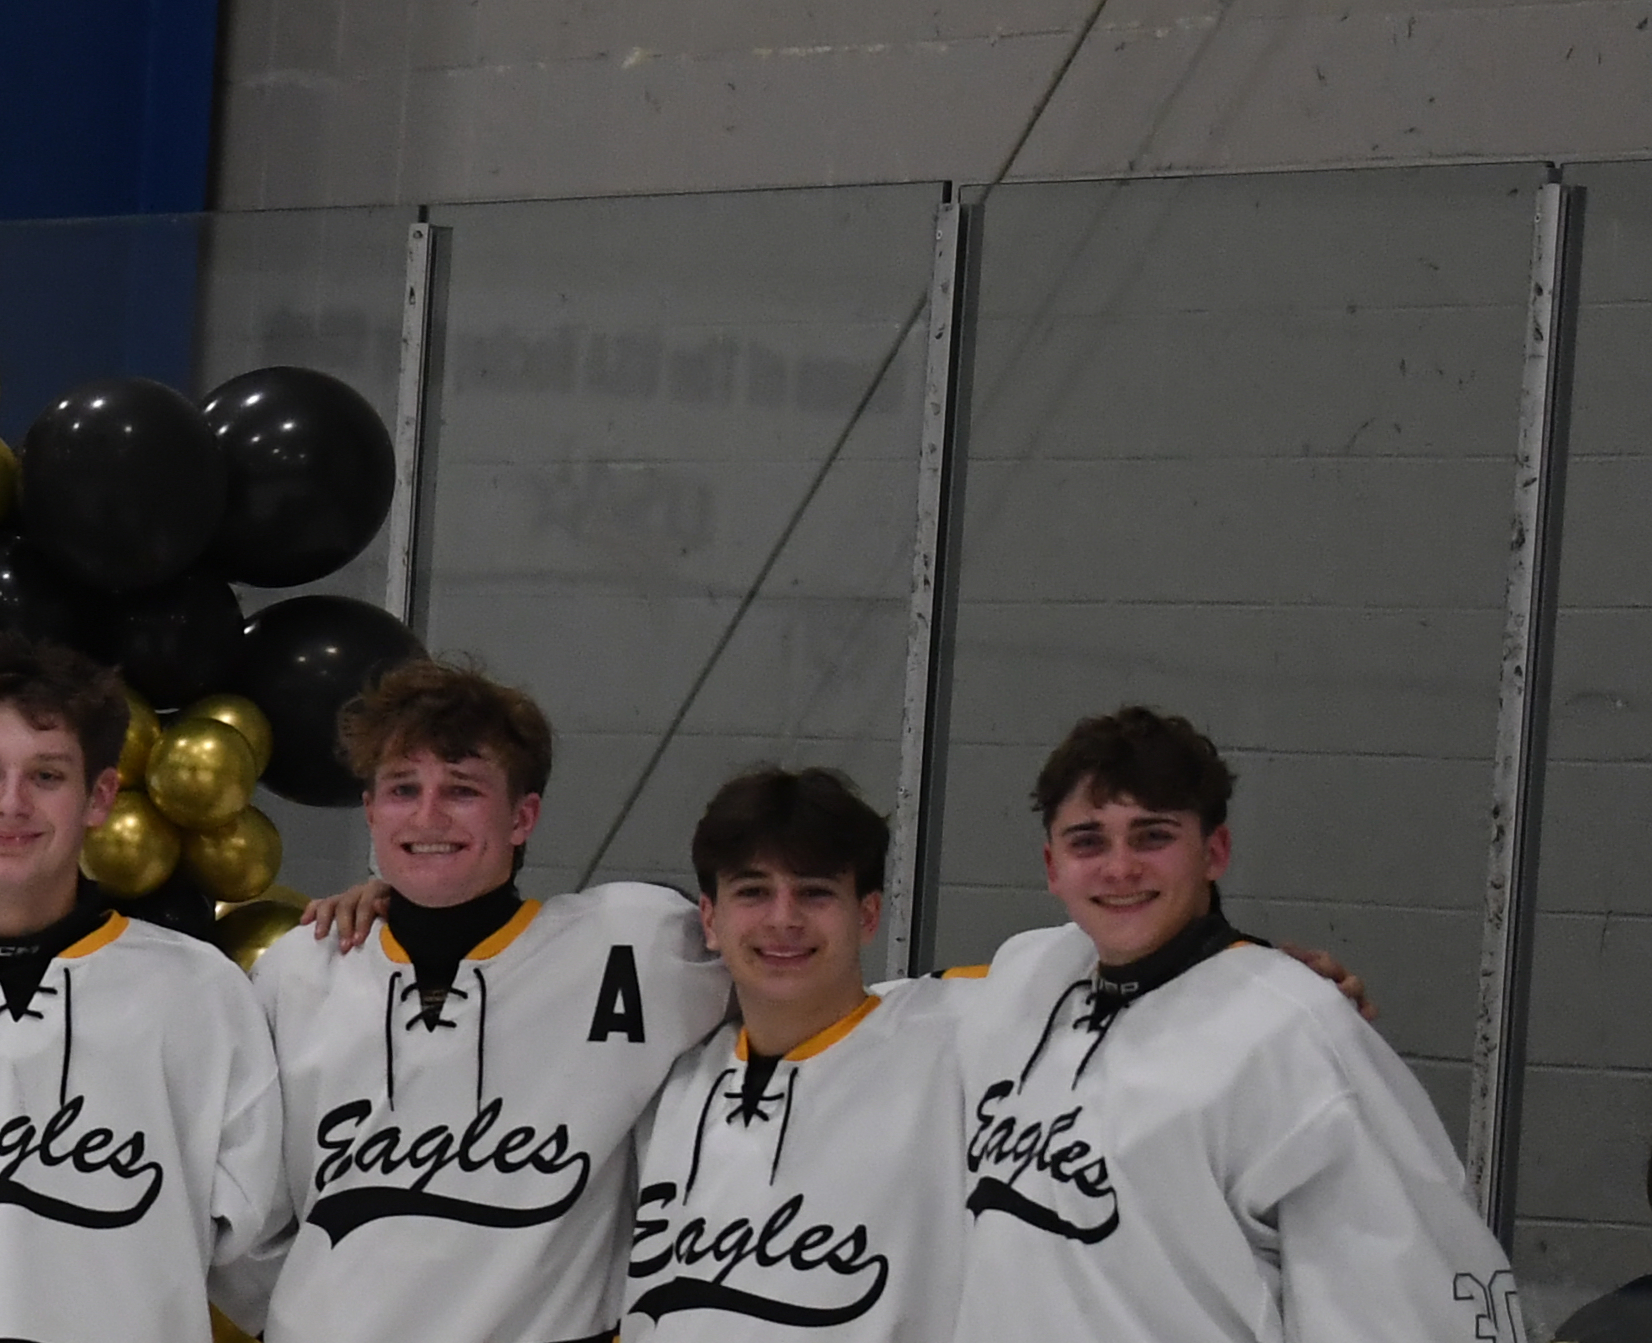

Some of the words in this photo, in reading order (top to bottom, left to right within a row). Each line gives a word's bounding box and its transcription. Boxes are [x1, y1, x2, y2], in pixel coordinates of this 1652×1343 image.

[588, 944, 646, 1043] A
[314, 1095, 575, 1195] Eagles
[967, 1079, 1113, 1200] Eagles
[628, 1181, 875, 1282] Eagles
